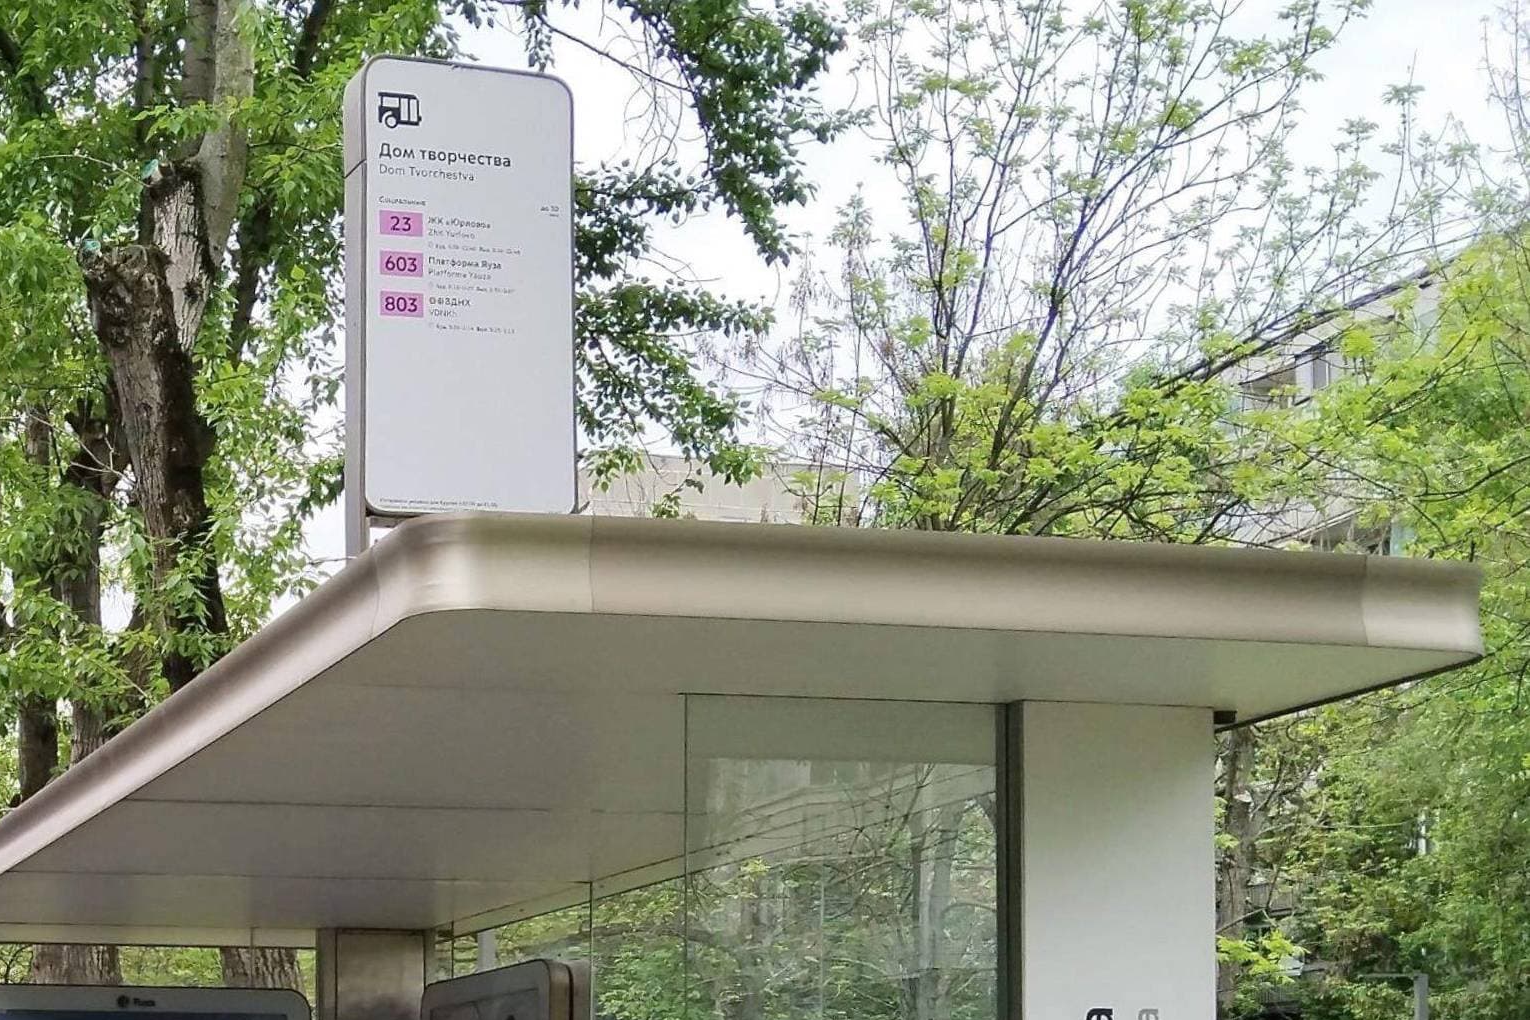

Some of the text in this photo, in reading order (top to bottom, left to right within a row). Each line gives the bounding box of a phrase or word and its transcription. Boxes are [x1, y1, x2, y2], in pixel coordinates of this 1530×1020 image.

[379, 142, 511, 168] Дом творчества
[379, 163, 474, 181] Dom Tvorchestva
[390, 215, 411, 231] 23
[385, 255, 417, 272] 603
[428, 256, 479, 268] Платформа
[385, 296, 418, 312] 803
